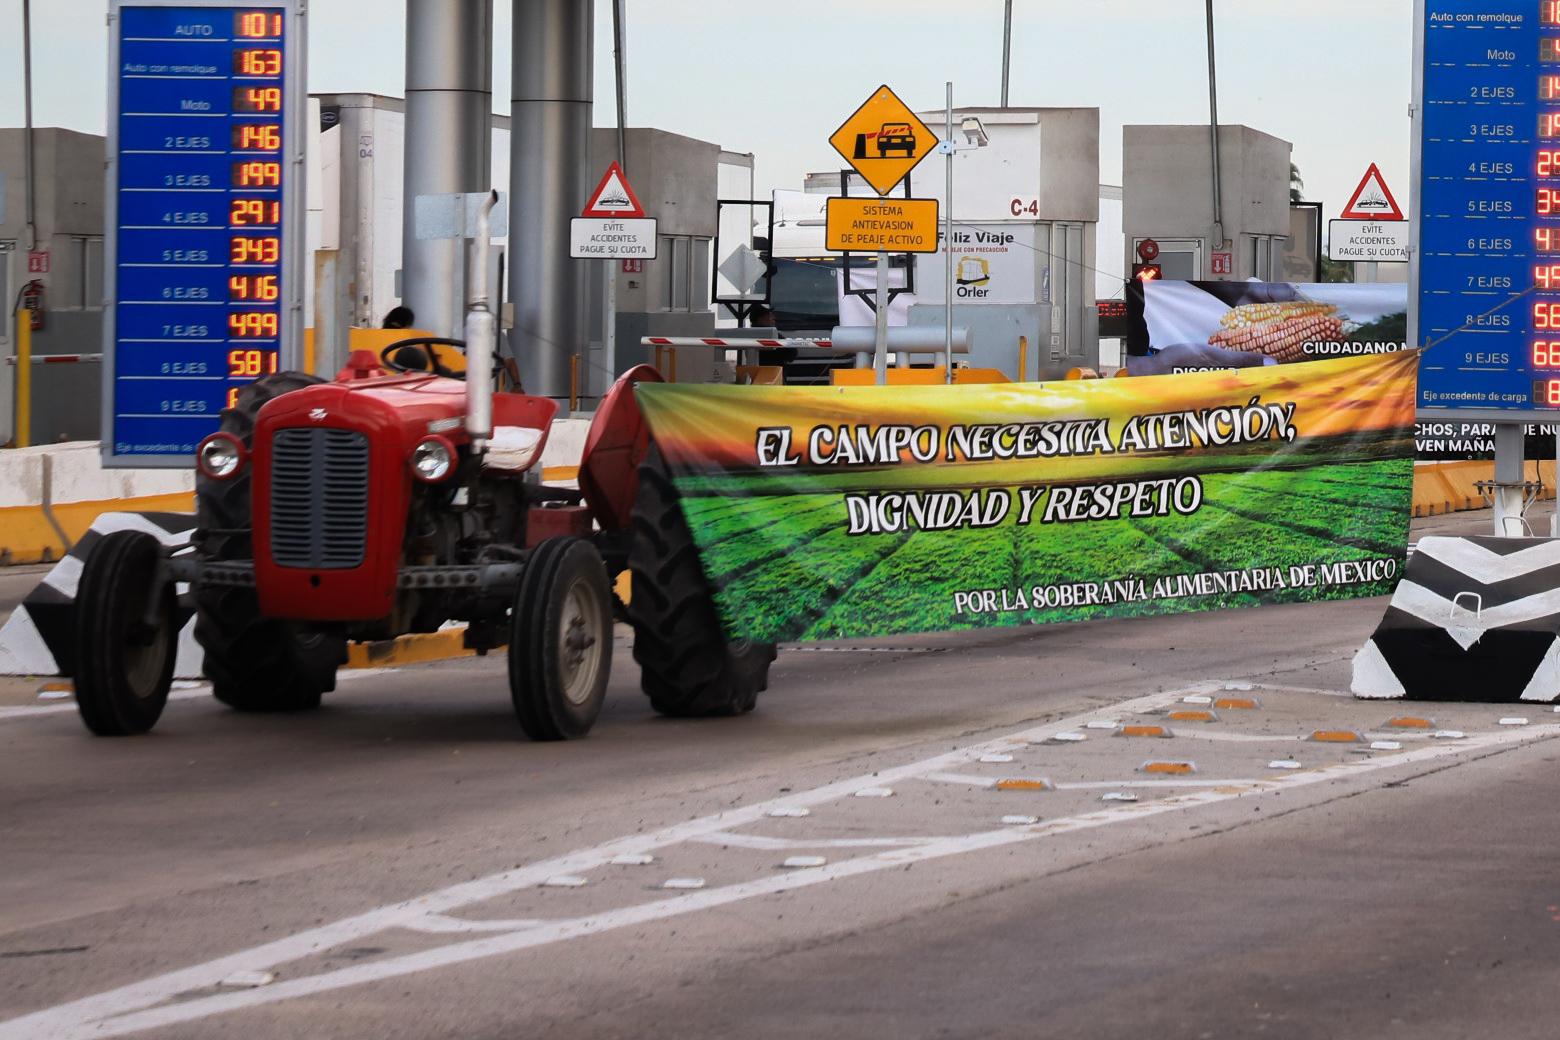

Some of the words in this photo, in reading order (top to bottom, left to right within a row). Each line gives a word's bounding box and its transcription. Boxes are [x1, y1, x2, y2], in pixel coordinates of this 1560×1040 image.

[1430, 12, 1453, 22] Auto
[1456, 14, 1474, 22] con
[1477, 13, 1523, 24] remolque
[174, 25, 213, 36] AUTO
[241, 13, 282, 37] 101
[1487, 49, 1516, 60] Moto
[123, 63, 147, 72] Auto
[150, 65, 169, 73] con
[170, 64, 217, 75] remolque
[241, 50, 282, 75] 163
[1470, 87, 1478, 98] 2
[1481, 87, 1514, 98] EJES
[180, 100, 211, 111] Moto
[247, 88, 281, 111] 49
[1470, 125, 1477, 135] 3
[1481, 125, 1514, 136] EJES
[175, 137, 211, 148] EJES
[241, 125, 281, 150] 146
[1468, 163, 1476, 173] 4
[1480, 163, 1513, 173] EJES
[175, 175, 211, 186] EJES
[240, 163, 280, 186] 199
[162, 213, 171, 223] 4
[174, 212, 209, 224] EJES
[230, 200, 280, 225] 291
[863, 206, 903, 216] SISTEMA
[1010, 198, 1039, 217] C-4
[1468, 201, 1475, 211] 5
[1479, 201, 1512, 212] EJES
[603, 223, 625, 232] EVITE
[852, 220, 914, 230] ANTIEVASION
[1362, 225, 1383, 233] EVITE
[590, 235, 637, 243] ACCIDENTES
[841, 234, 853, 243] DE
[857, 234, 886, 244] PEAJE
[887, 235, 923, 245] ACTIVO
[975, 231, 1014, 245] Viaje
[1349, 237, 1396, 245] ACCIDENTES
[162, 250, 172, 261] 5
[174, 250, 209, 261] EJES
[231, 238, 279, 262] 343
[580, 246, 605, 254] PAGUE
[608, 246, 618, 254] SU
[620, 246, 647, 254] CUOTA
[1468, 239, 1475, 249] 6
[1479, 239, 1512, 250] EJES
[1338, 248, 1365, 256] PAGUE
[1367, 248, 1377, 256] SU
[1379, 248, 1406, 256] CUOTA
[174, 288, 209, 298] EJES
[229, 275, 278, 300] 416
[1467, 277, 1474, 287] 7
[1478, 277, 1511, 288] EJES
[956, 286, 989, 298] Orler
[162, 325, 171, 336] 7
[173, 325, 209, 336] EJES
[229, 313, 278, 336] 499
[1466, 314, 1473, 325] 8
[1477, 314, 1510, 326] EJES
[1303, 341, 1397, 354] CIUDADANO
[172, 362, 208, 374] EJES
[228, 351, 277, 375] 581
[1465, 353, 1472, 363] 9
[1476, 352, 1509, 364] EJES
[1423, 390, 1438, 402] Eje
[1440, 391, 1486, 401] excedente
[1488, 391, 1500, 401] de
[1502, 393, 1527, 403] carga
[172, 400, 207, 411] EJES
[757, 428, 799, 466] EL
[809, 426, 939, 464] CAMPO
[948, 419, 1113, 460] NECESITA
[1120, 396, 1296, 451] ATENCIÓN,
[847, 491, 1009, 534] DIGNIDAD
[1017, 488, 1044, 524] Y
[1044, 475, 1202, 522] RESPETO
[954, 589, 998, 613] POR
[1001, 588, 1029, 610] LA
[1032, 573, 1147, 609] SOBERANÍA
[1152, 566, 1285, 600] ALIMENTARIA
[1290, 564, 1317, 587] DE
[1321, 558, 1396, 585] MEXICO
